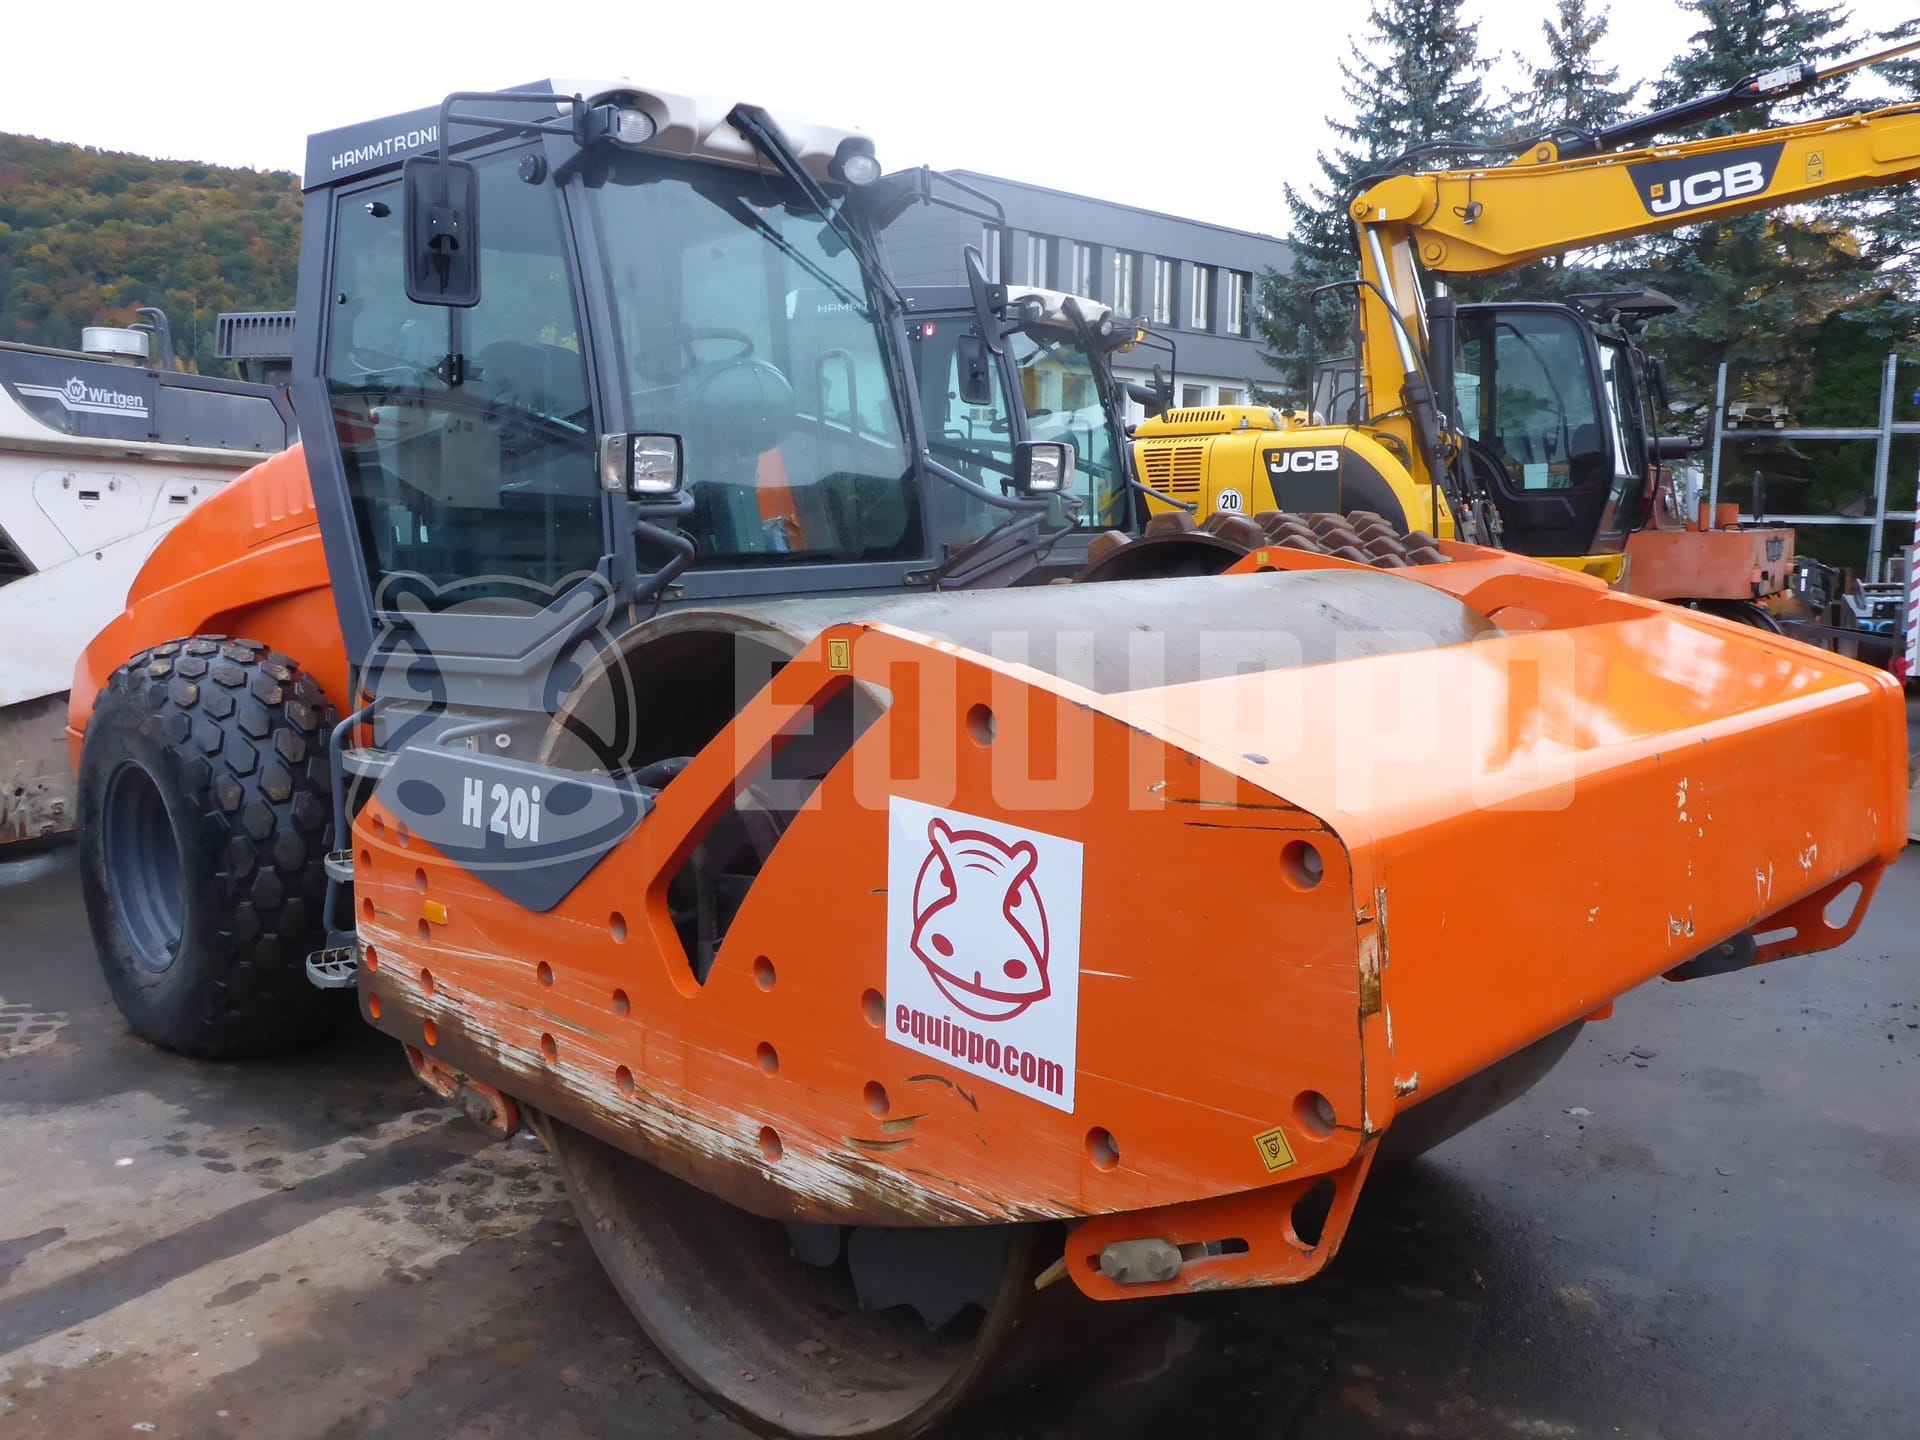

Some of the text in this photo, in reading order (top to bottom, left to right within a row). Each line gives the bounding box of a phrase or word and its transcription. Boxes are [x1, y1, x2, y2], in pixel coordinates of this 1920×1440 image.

[331, 125, 440, 171] HAMMTRONI
[1651, 161, 1765, 213] JCB
[89, 387, 143, 408] Wirtgen
[1270, 450, 1339, 473] JCB
[1221, 494, 1238, 509] 20
[462, 777, 540, 843] H 20i
[895, 1004, 1063, 1096] equippo.com
